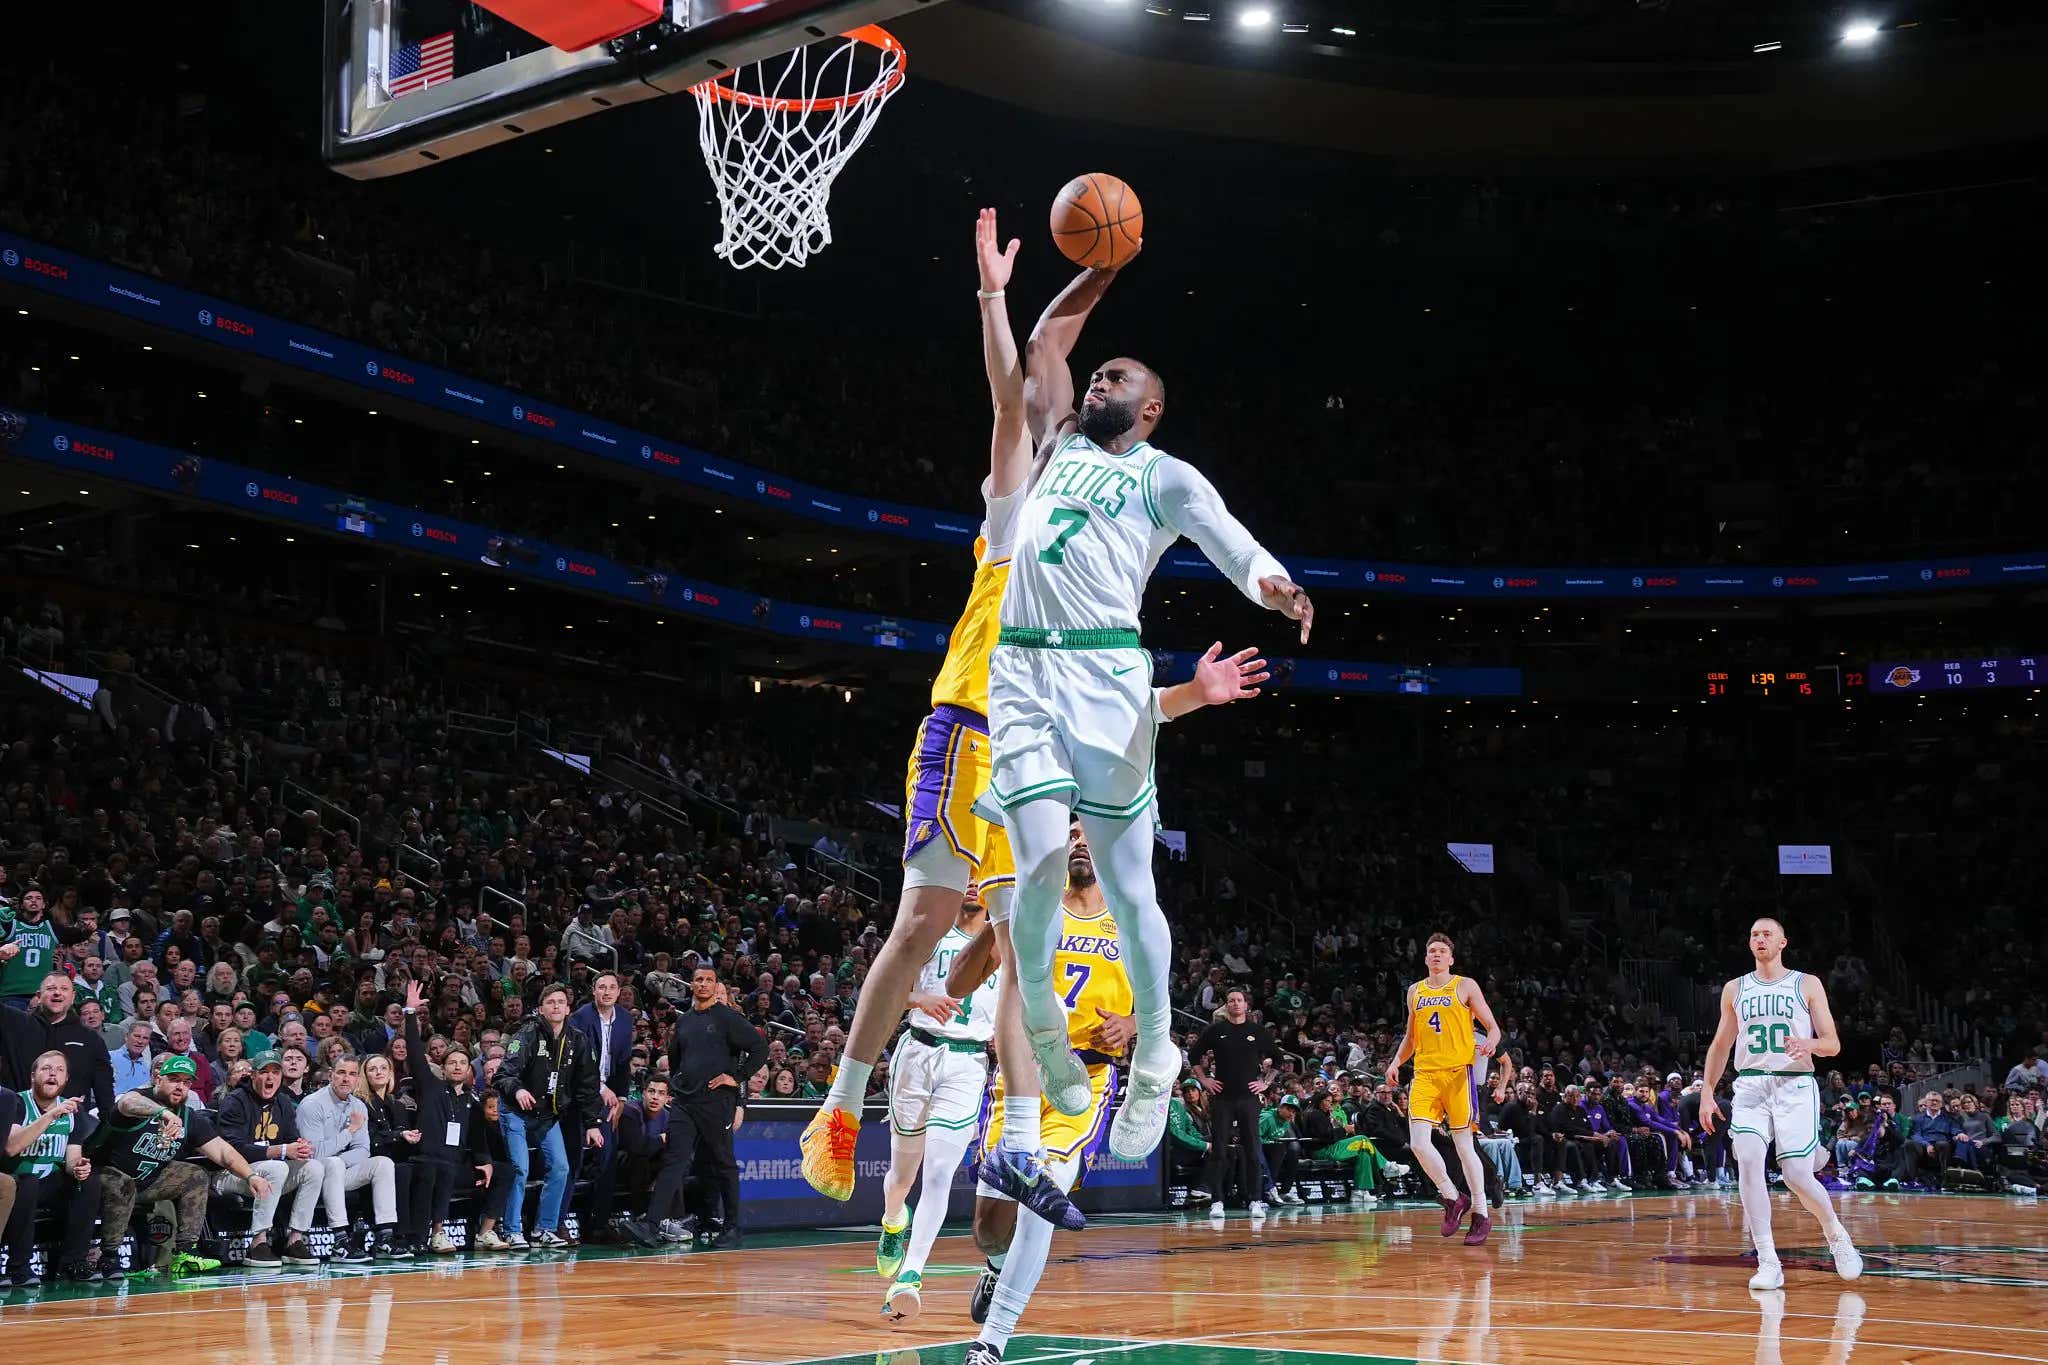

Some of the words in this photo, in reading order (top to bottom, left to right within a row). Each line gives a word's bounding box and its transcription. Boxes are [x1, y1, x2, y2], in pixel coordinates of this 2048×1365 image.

[24, 257, 69, 279] BOSCH
[216, 316, 255, 336] BOSCH
[382, 367, 416, 385] BOSCH
[527, 412, 557, 428] BOSCH
[72, 441, 115, 460] BOSCH
[263, 488, 298, 504] BOSCH
[1036, 461, 1137, 519] CELTICS
[426, 527, 457, 543] BOSCH
[1037, 507, 1090, 566] 7
[1981, 660, 1998, 668] AST
[2020, 658, 2036, 666] STL
[1340, 671, 1368, 681] BOSCH
[1751, 673, 1775, 685] 1:39
[1846, 673, 1864, 686] 22
[1946, 673, 1963, 685] 10
[1986, 671, 1996, 683] 3
[2027, 669, 2035, 681] 1
[1708, 683, 1724, 695] 31
[1800, 683, 1812, 695] 15
[1056, 935, 1120, 961] AKERS
[25, 948, 41, 967] 0
[1064, 963, 1091, 1008] 7
[1415, 995, 1452, 1011] LAKERS
[1741, 993, 1794, 1022] CELTICS
[1428, 1011, 1442, 1033] 4
[1747, 1023, 1791, 1055] 30
[32, 1163, 55, 1180] 7
[136, 1160, 160, 1181] 7
[857, 1161, 892, 1178] TUES
